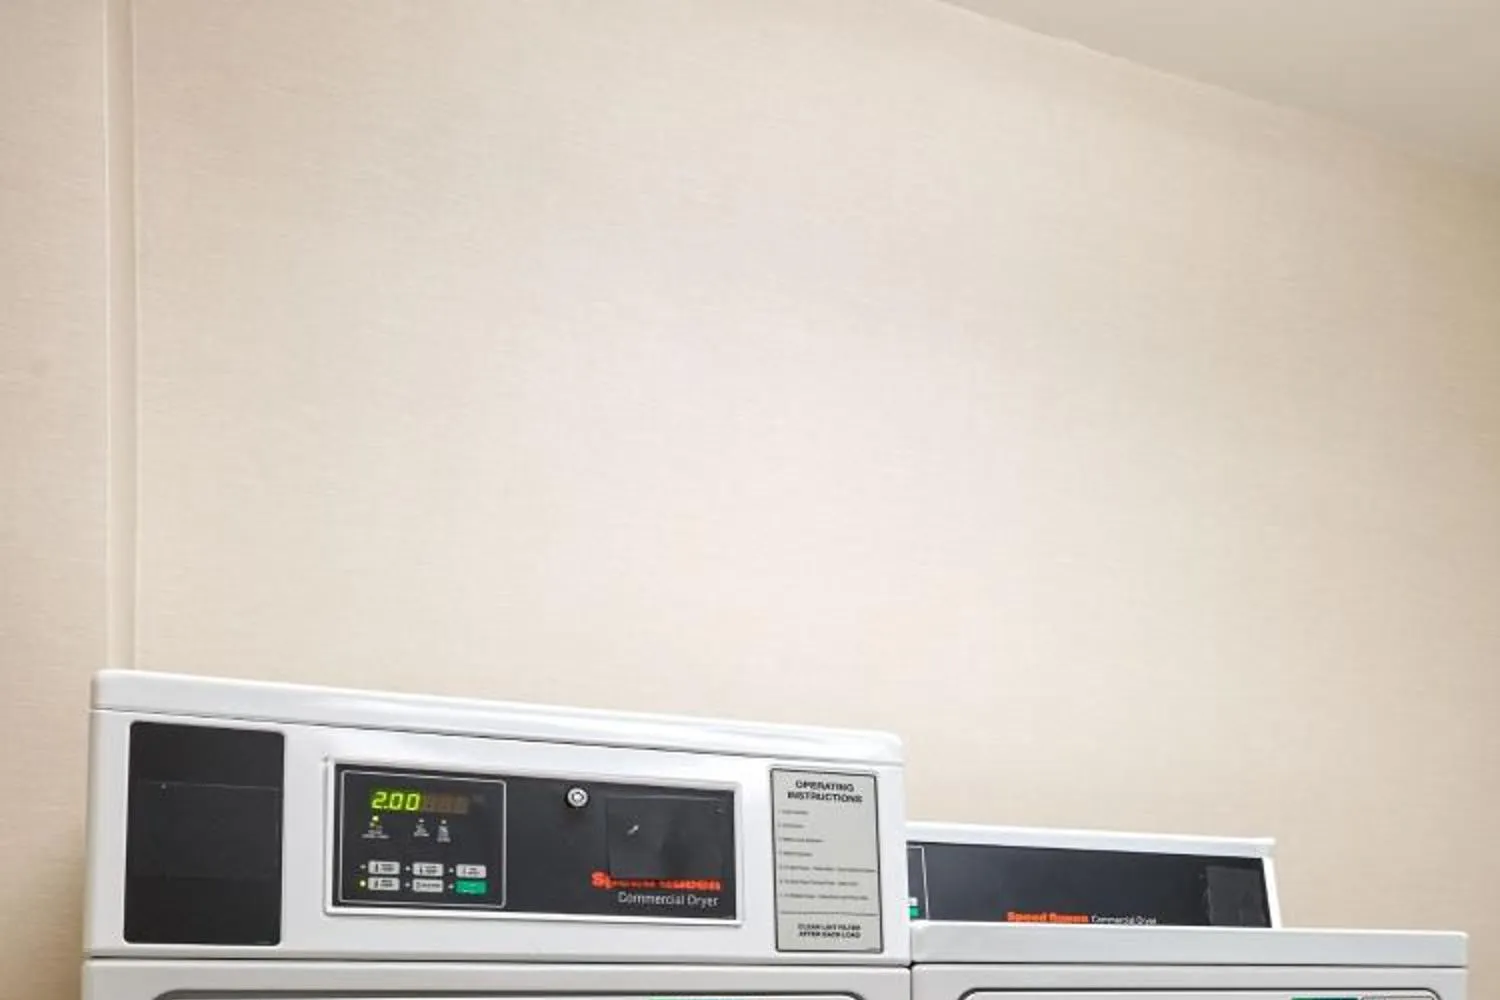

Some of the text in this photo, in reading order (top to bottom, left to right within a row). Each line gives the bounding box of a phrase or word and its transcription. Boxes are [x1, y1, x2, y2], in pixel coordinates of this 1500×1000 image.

[795, 780, 855, 792] OPERATING
[371, 791, 420, 811] 2.00
[787, 791, 863, 803] INSTRUCTIONS
[618, 890, 719, 909] Commercial Dryer
[1007, 911, 1047, 923] Speed
[1049, 912, 1088, 924] Queen
